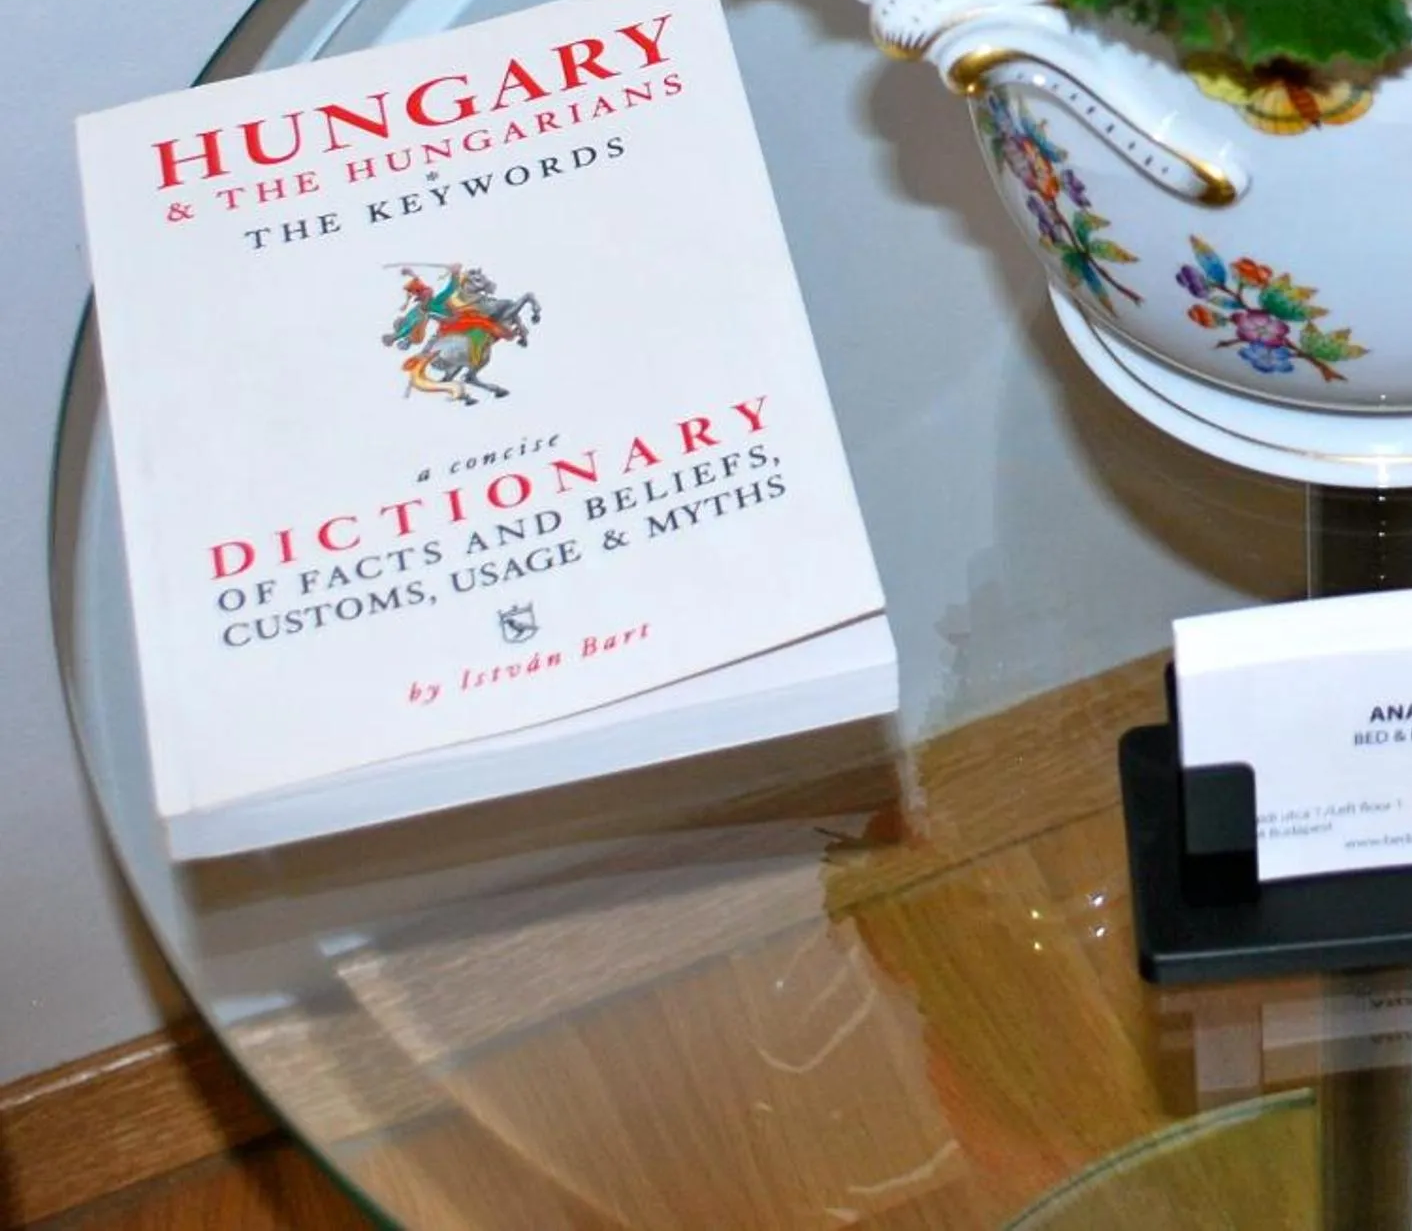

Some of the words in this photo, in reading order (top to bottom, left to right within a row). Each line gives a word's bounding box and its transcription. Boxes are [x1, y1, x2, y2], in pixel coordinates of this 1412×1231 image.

[151, 14, 673, 190] HUNGARY
[166, 201, 195, 223] &
[217, 171, 321, 211] THE
[346, 72, 684, 185] HUNGARIANS
[244, 212, 341, 251] THE
[368, 136, 627, 224] KEYWORDS
[209, 395, 768, 580] DICTIONARY
[216, 579, 278, 612] OF
[300, 540, 444, 595] FACTS
[466, 509, 562, 555] AND
[583, 443, 781, 521] BELIEFS,
[416, 467, 431, 483] a
[449, 433, 560, 475] concise
[222, 580, 437, 647] CUSTOMS,
[450, 538, 582, 593] USAGE
[602, 528, 631, 551] &
[646, 473, 786, 539] MYTHS
[408, 681, 440, 705] by
[460, 652, 562, 691] István
[580, 622, 651, 658] Bart
[1354, 729, 1389, 746] BED
[1394, 729, 1407, 743] &
